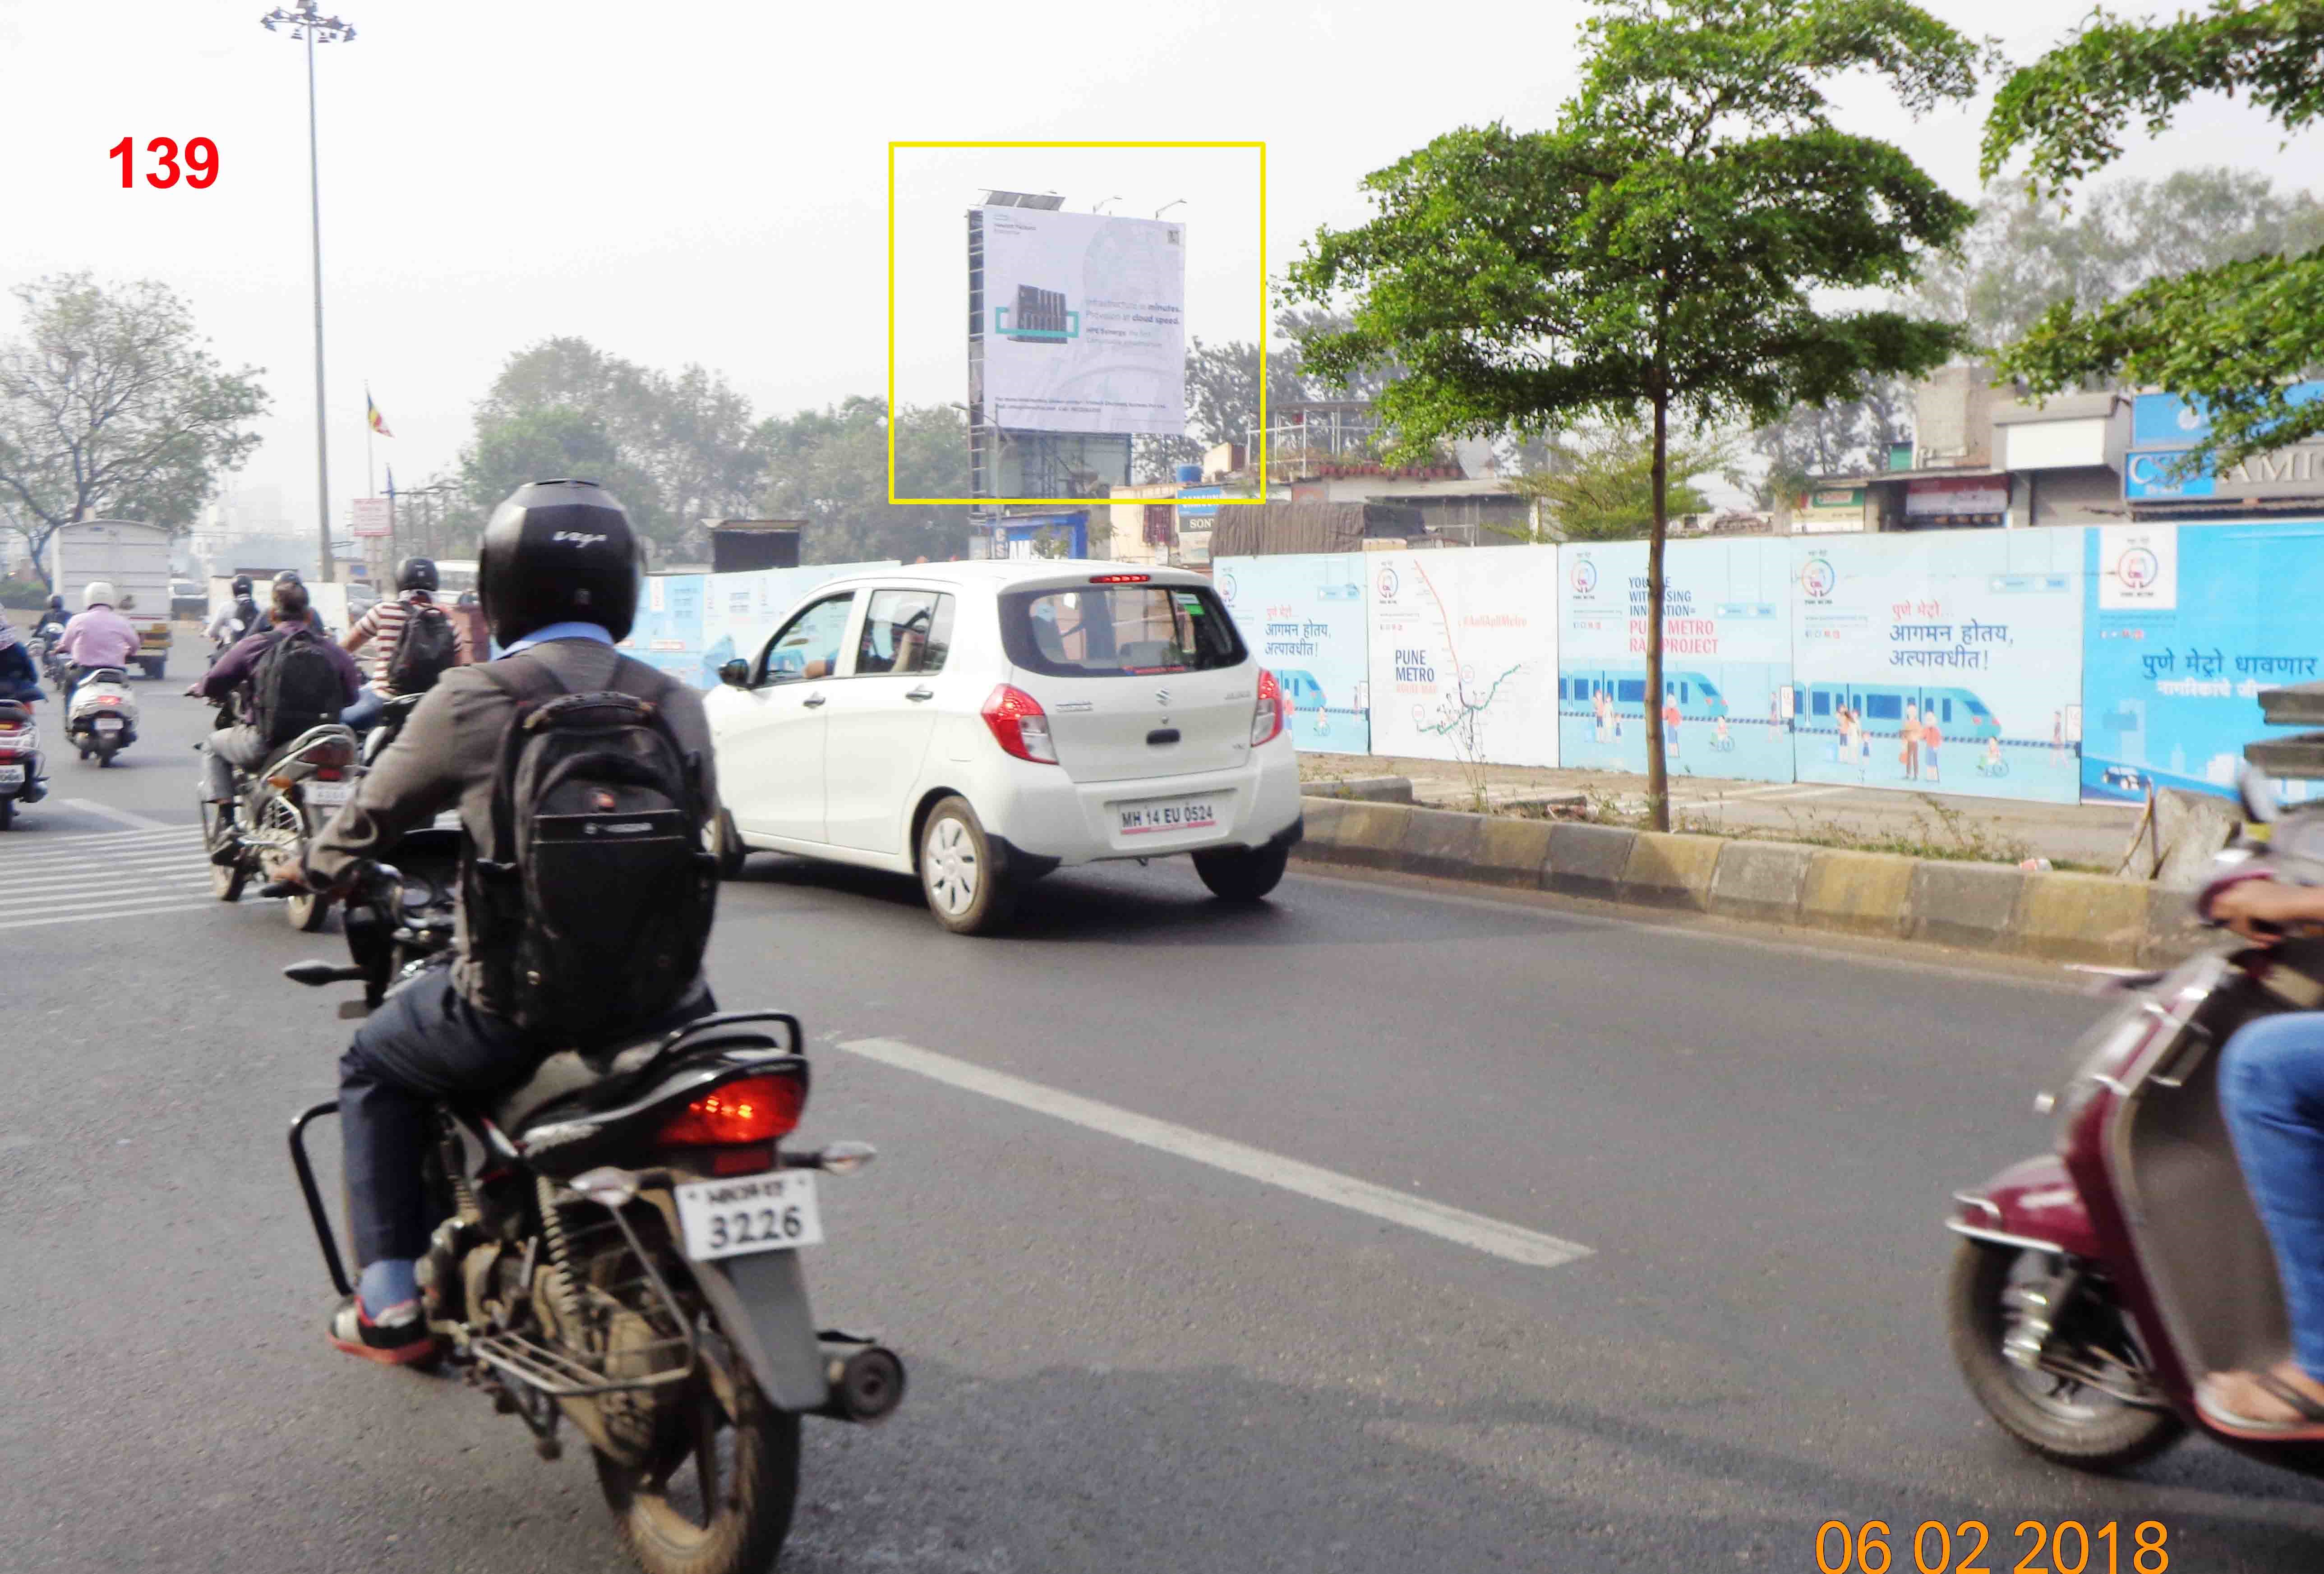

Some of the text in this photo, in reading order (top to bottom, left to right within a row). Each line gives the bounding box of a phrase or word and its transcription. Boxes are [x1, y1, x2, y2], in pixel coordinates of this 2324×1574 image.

[1132, 313, 1153, 323] cloud
[1155, 317, 1180, 325] speed.
[2129, 450, 2324, 484] CAMI
[1190, 518, 1214, 528] SON
[1629, 590, 1692, 603] WITSING
[1264, 624, 1299, 637] आगमन
[1668, 620, 1714, 635] METRO
[1889, 625, 1953, 642] आगमन
[1661, 638, 1718, 654] PROJECT
[1395, 649, 1426, 665] PUNE
[2142, 647, 2319, 680] पुणे मेट्रो धावणार
[1396, 667, 1435, 682] METRO
[1122, 805, 1213, 828] MH 14 EU 0524
[709, 1206, 802, 1249] 3226
